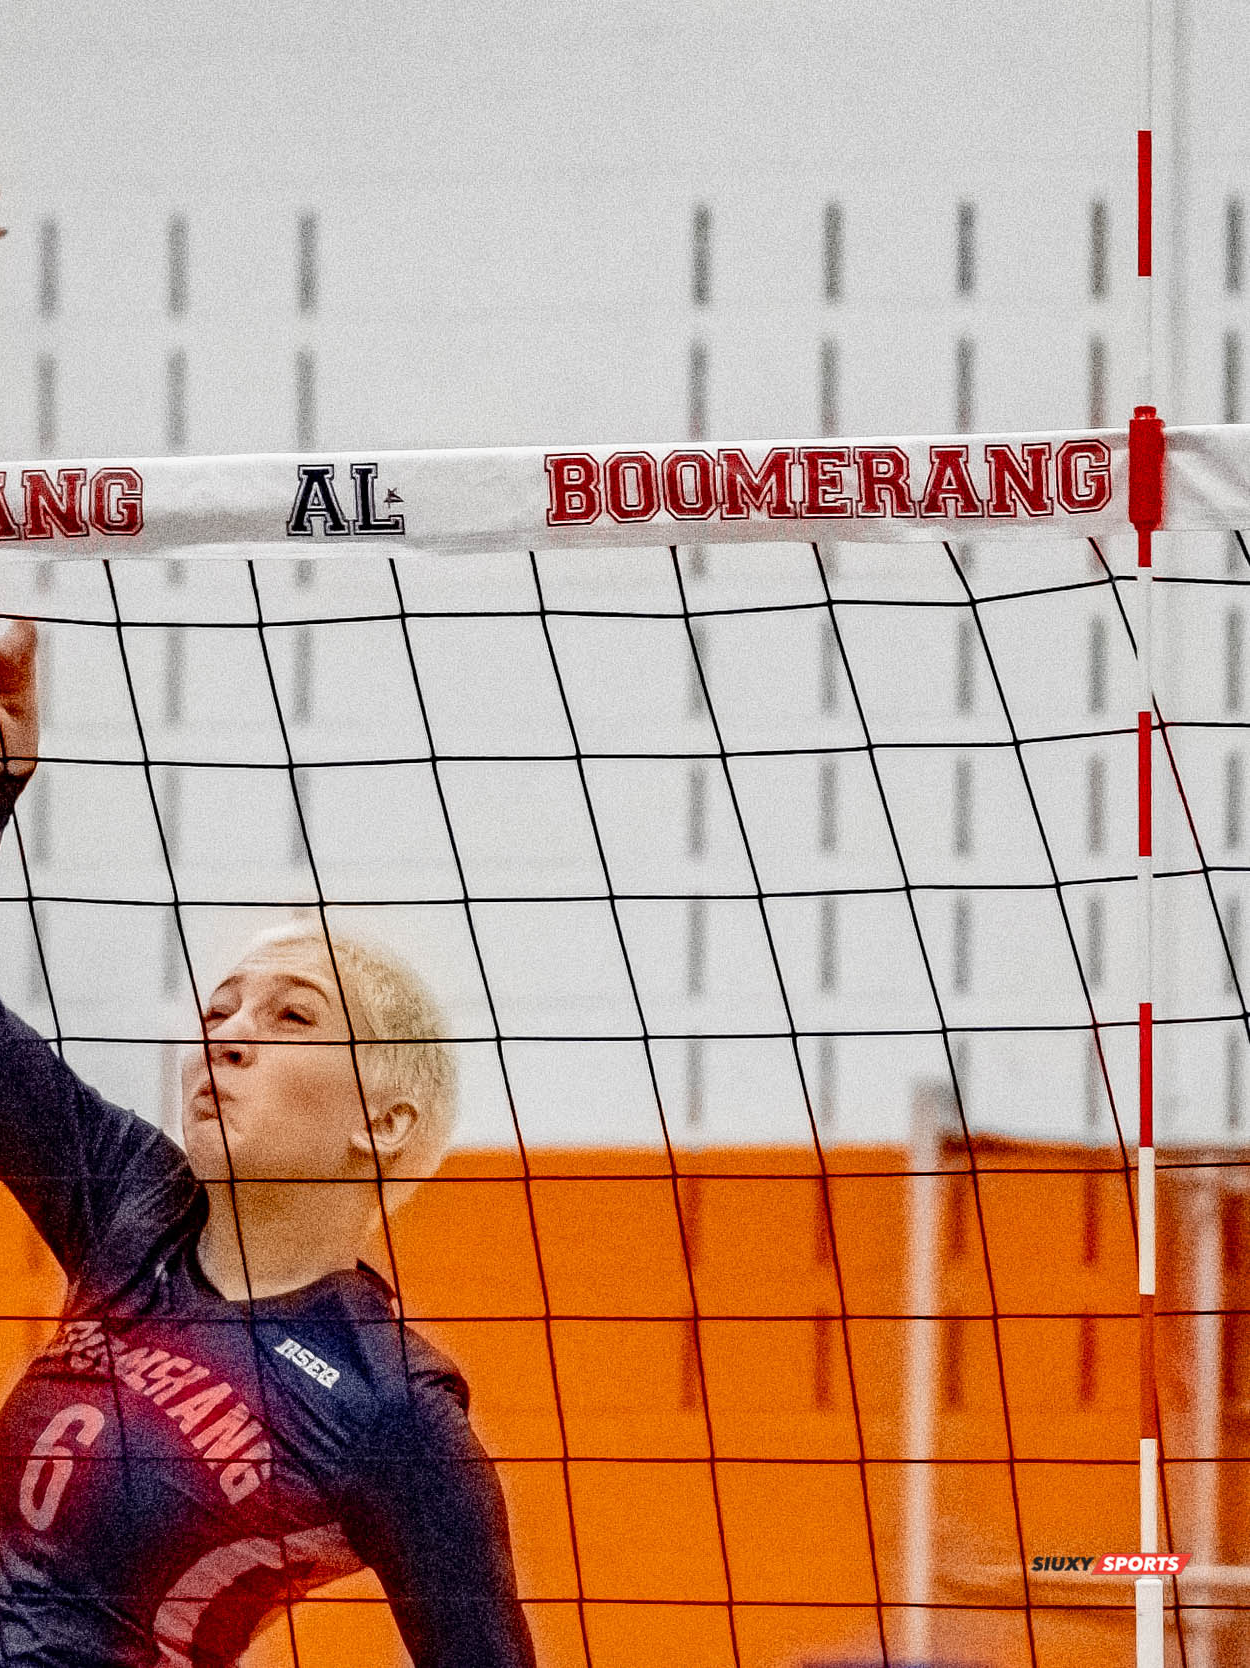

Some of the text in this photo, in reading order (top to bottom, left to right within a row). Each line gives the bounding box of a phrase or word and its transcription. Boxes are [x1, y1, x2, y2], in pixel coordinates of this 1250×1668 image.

[286, 462, 406, 537] AL
[544, 438, 1112, 527] BOOMERANG
[18, 1403, 105, 1532] 6
